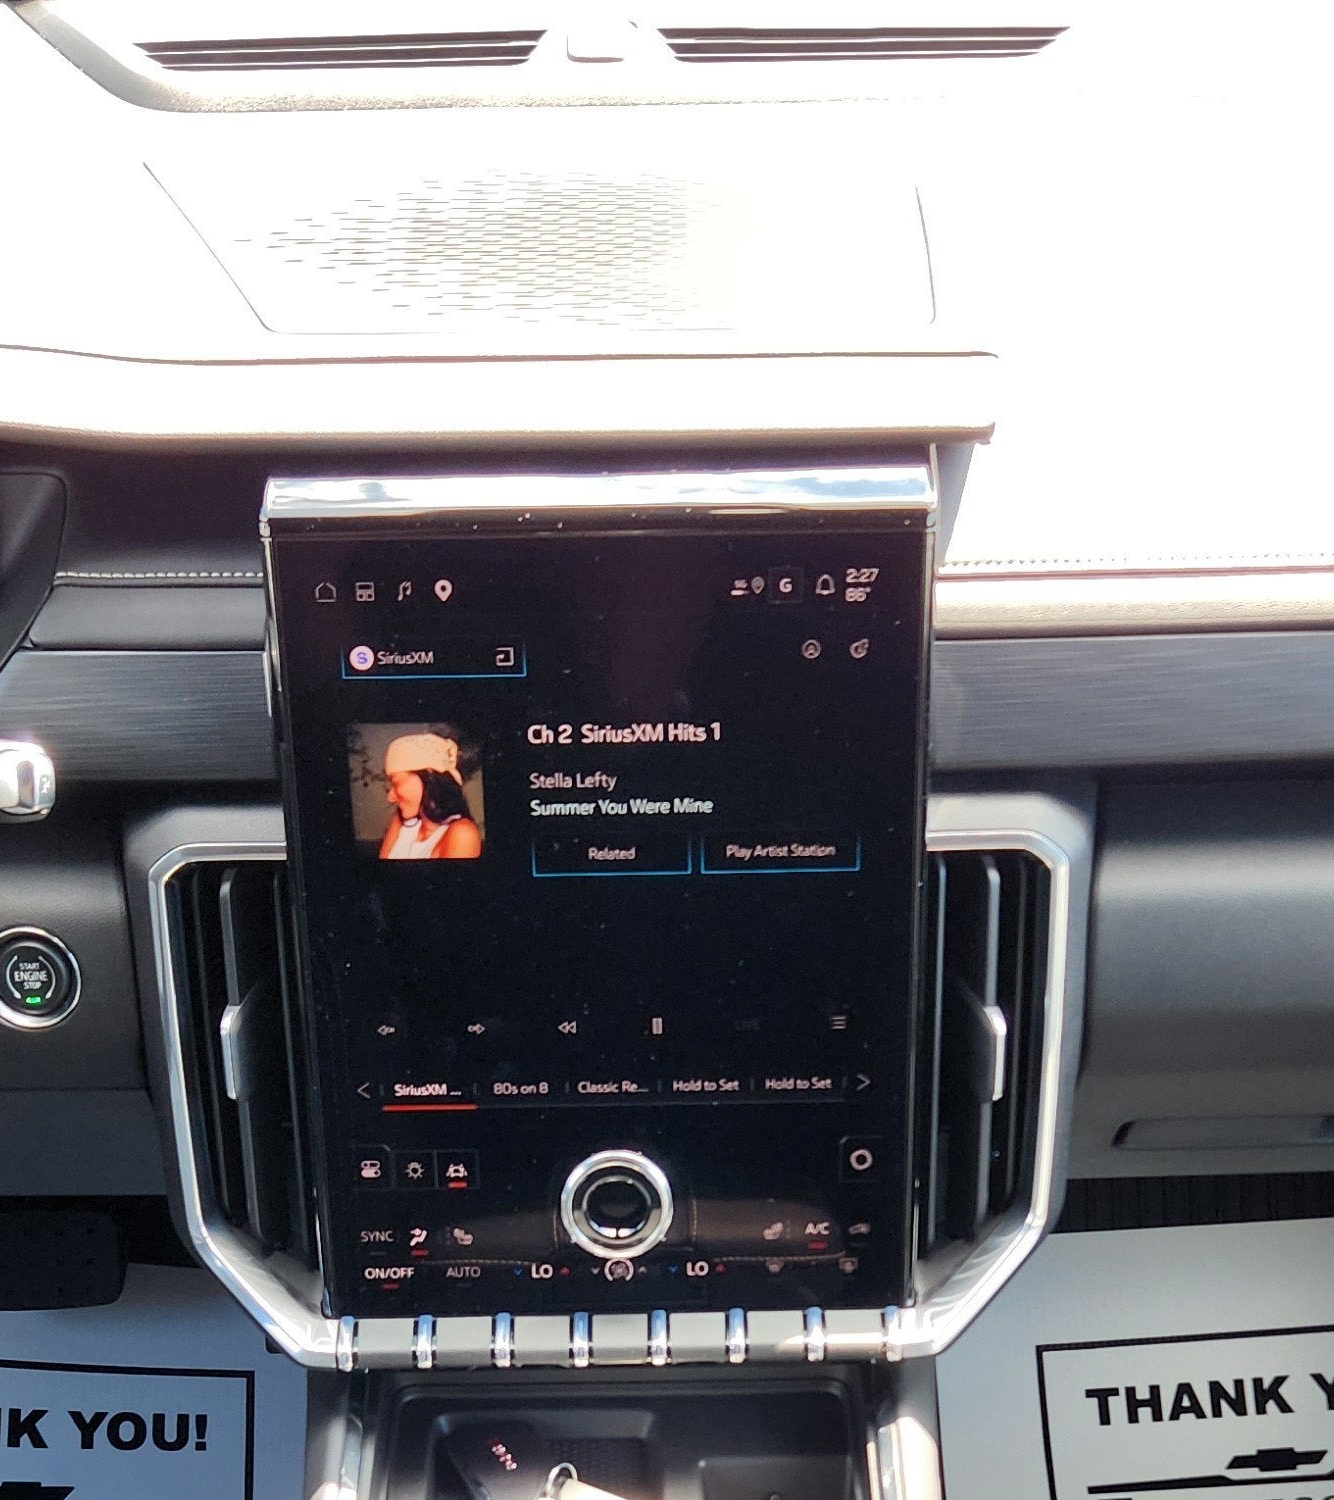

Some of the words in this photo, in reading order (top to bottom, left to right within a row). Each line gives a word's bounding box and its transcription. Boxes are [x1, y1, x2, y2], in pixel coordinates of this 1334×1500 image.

[377, 651, 434, 665] SiriusXM
[527, 724, 554, 744] Ch
[558, 724, 573, 744] 2
[581, 723, 664, 743] SiriusXM
[668, 722, 707, 742] Hits
[710, 722, 721, 741] 1
[529, 772, 573, 789] Stella
[576, 771, 617, 791] Lefty
[530, 800, 596, 816] Summer
[598, 799, 628, 815] You
[629, 799, 670, 814] Were
[673, 797, 714, 814] Mine
[588, 847, 636, 860] Related
[726, 844, 753, 860] Play
[753, 845, 788, 857] Artist
[790, 843, 836, 857] Station
[14, 970, 49, 982] ENGINE
[23, 981, 42, 989] STOP
[394, 1083, 447, 1097] SiriusXM
[493, 1082, 518, 1094] 80s
[520, 1085, 537, 1094] on
[539, 1082, 549, 1094] 8
[577, 1081, 618, 1094] Classic
[673, 1078, 702, 1092] Hold
[704, 1080, 717, 1091] to
[719, 1078, 740, 1091] Set
[765, 1077, 795, 1090] Hold
[796, 1079, 810, 1090] to
[811, 1077, 832, 1090] Set
[805, 1222, 831, 1235] A/C
[361, 1230, 394, 1243] SYNC
[364, 1267, 415, 1280] ON/OFF
[446, 1267, 481, 1278] AUTO
[531, 1264, 554, 1279] LO
[686, 1261, 709, 1276] LO
[1084, 1374, 1295, 1427] THANK
[67, 1410, 208, 1453] YOU!
